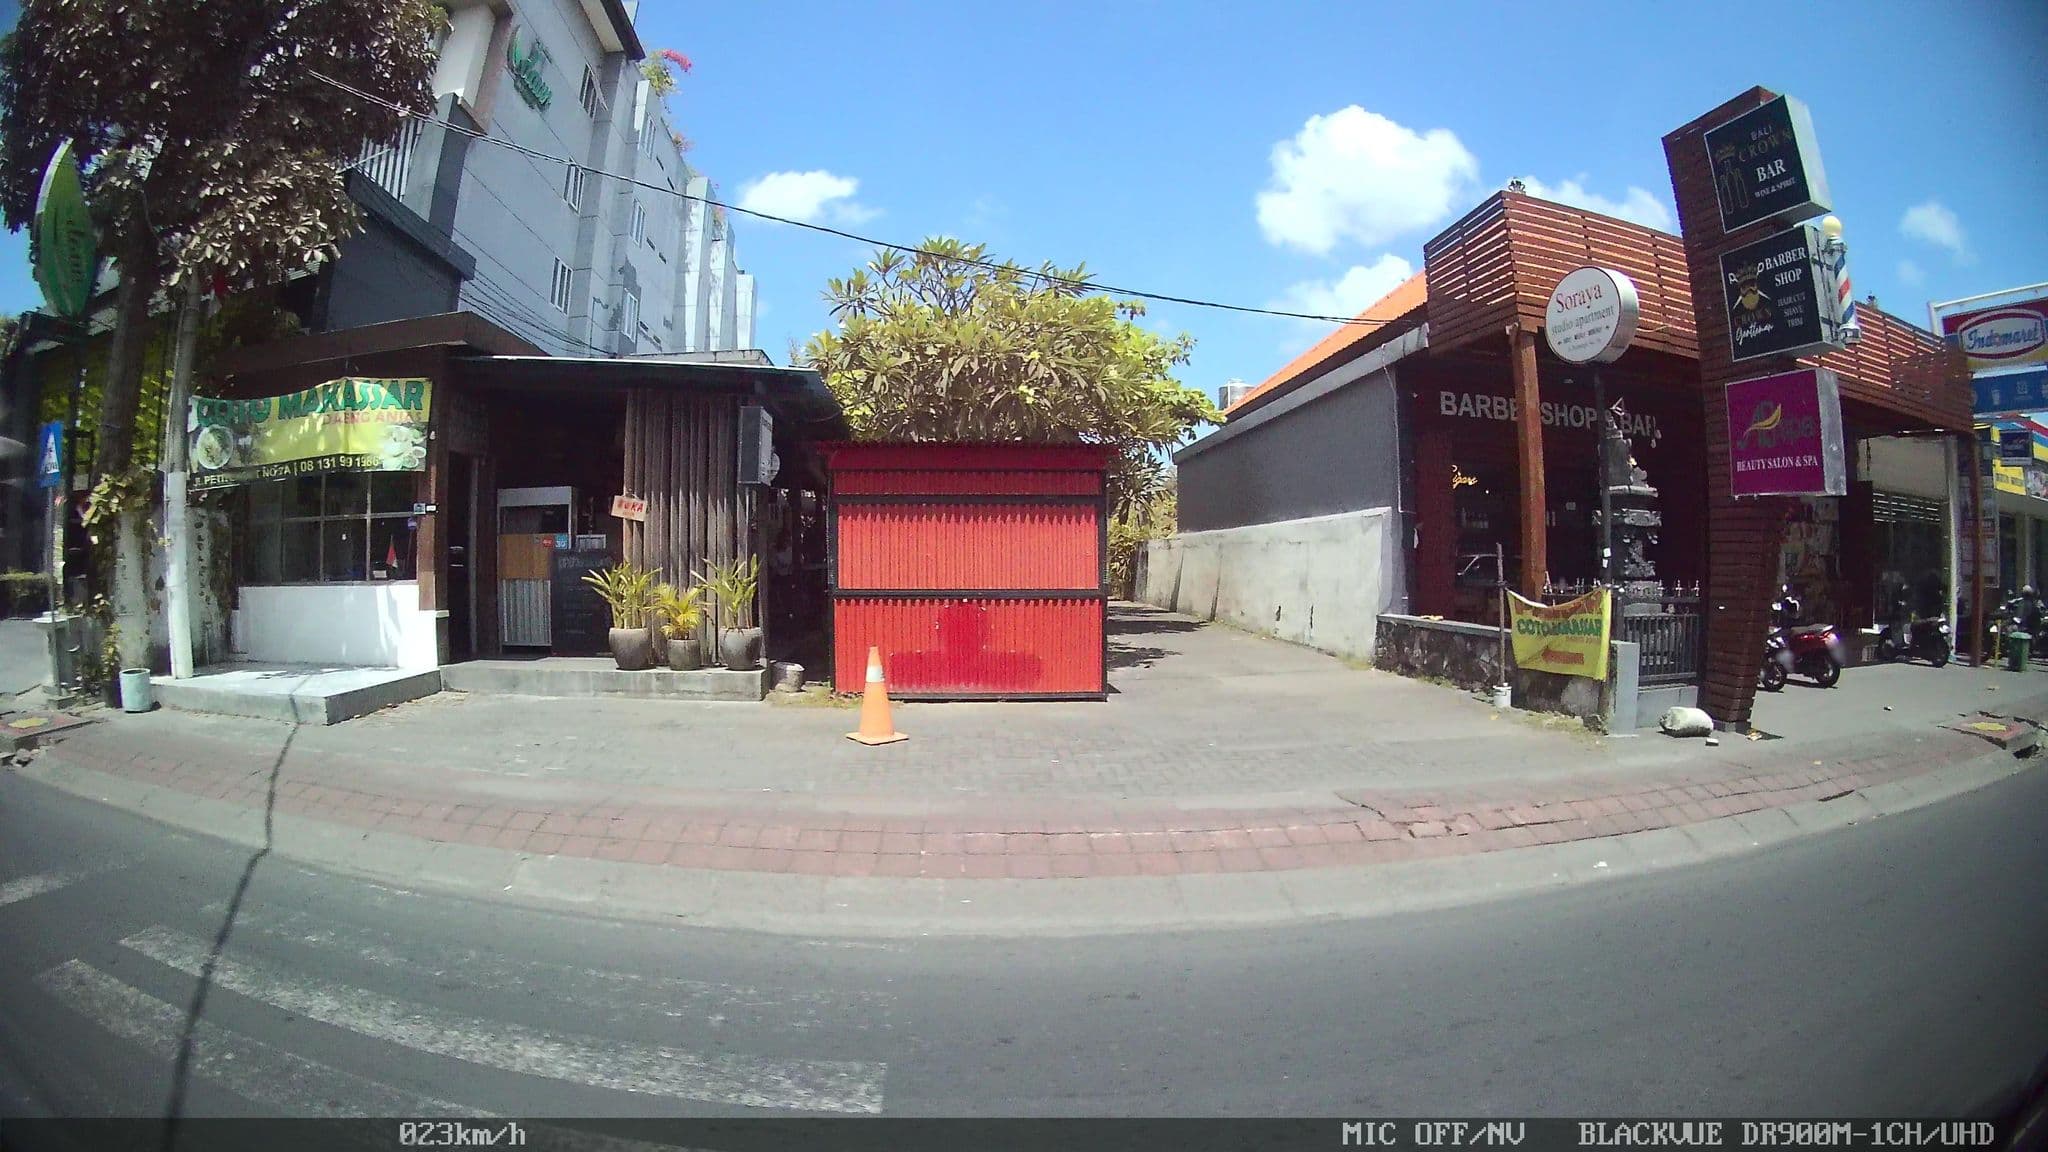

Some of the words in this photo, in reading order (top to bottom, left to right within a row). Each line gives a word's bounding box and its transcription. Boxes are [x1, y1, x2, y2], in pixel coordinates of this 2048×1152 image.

[1756, 158, 1786, 183] BAR
[1765, 246, 1807, 272] BARBER
[1774, 267, 1803, 288] SHOP
[1556, 283, 1603, 314] Soraya
[1575, 305, 1615, 330] apartment
[1967, 322, 2039, 350] Indomaret
[278, 380, 424, 420] MAKASSAR
[1540, 401, 1598, 430] SHOP
[300, 460, 314, 473] 08
[318, 457, 336, 470] 131
[340, 455, 353, 468] 99
[1736, 458, 1766, 472] BEAUTY
[1767, 456, 1794, 469] SALON
[1795, 455, 1802, 467] &
[1803, 454, 1818, 466] SPA
